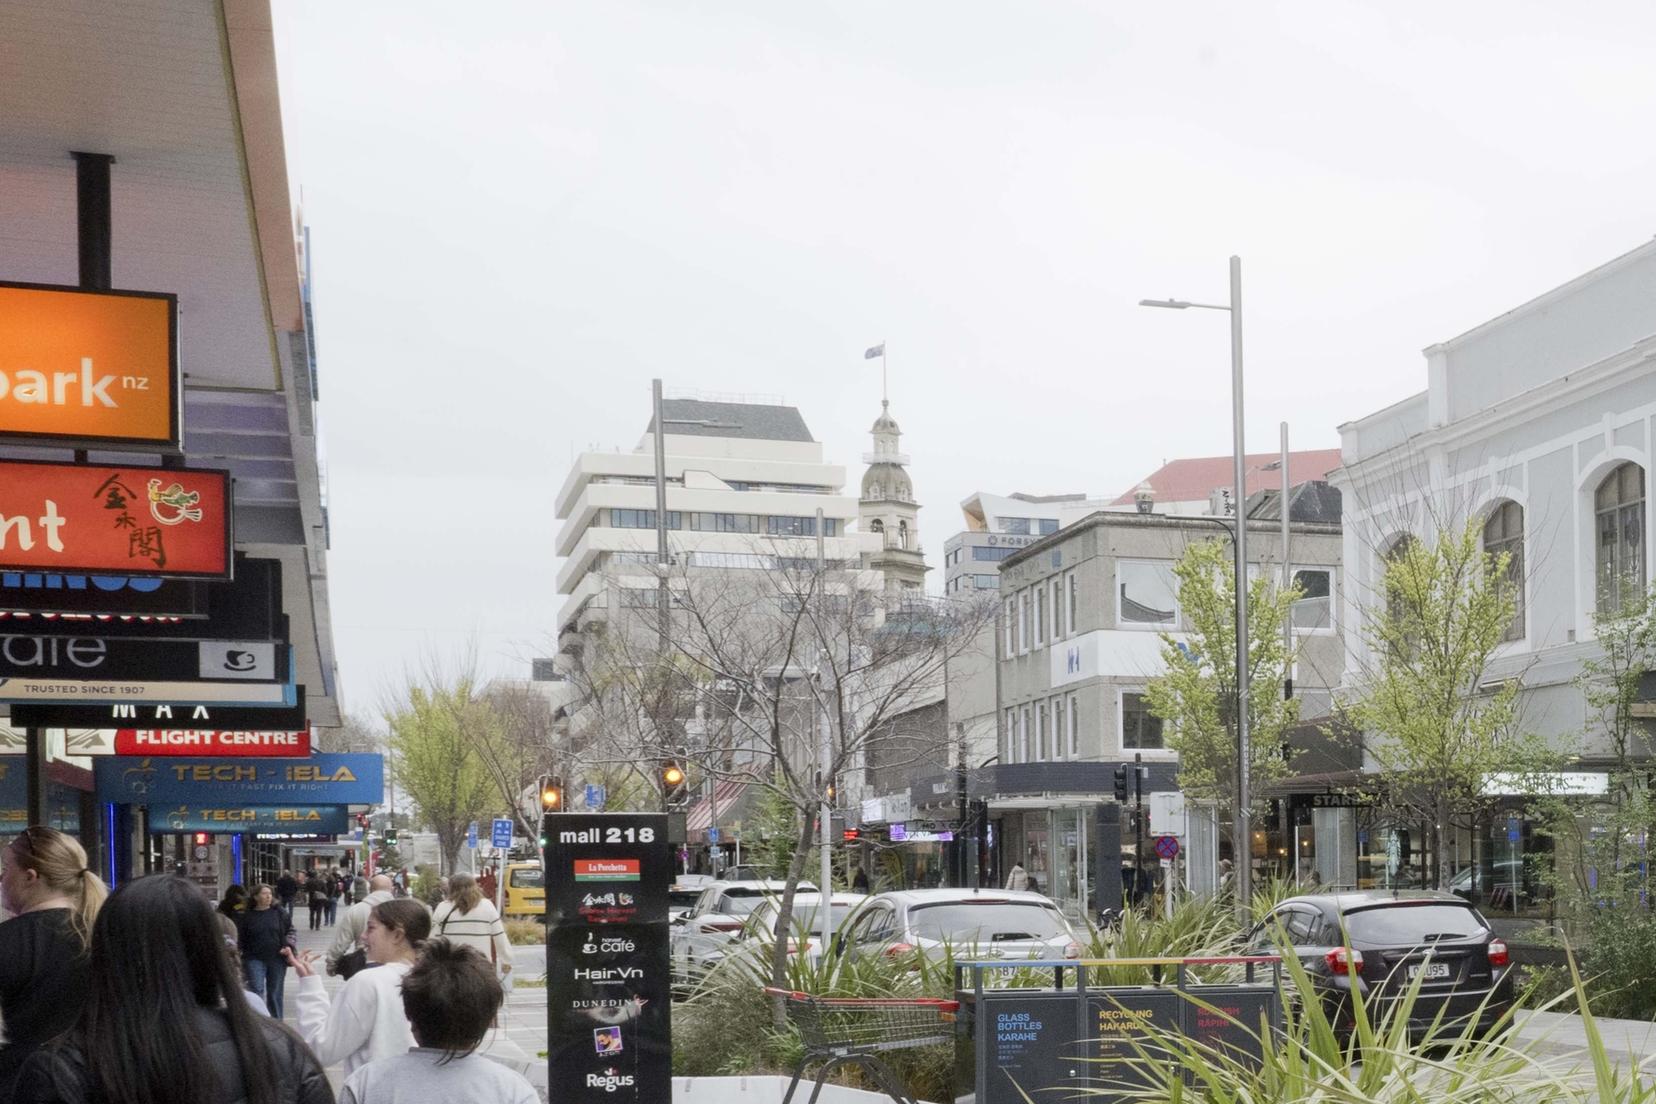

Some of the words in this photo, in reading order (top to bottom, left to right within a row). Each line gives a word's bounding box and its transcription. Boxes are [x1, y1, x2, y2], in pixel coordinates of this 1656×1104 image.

[122, 375, 149, 390] nz
[24, 685, 77, 694] TRUSTED
[81, 686, 115, 694] SINCE
[120, 686, 145, 695] 1907
[136, 730, 215, 745] FLIGHT
[219, 731, 299, 745] CENTRE
[170, 764, 257, 782] TECH
[201, 809, 257, 821] TECH
[560, 828, 600, 843] mall
[605, 827, 655, 843] 218
[600, 940, 635, 953] café
[574, 967, 644, 980] HairVn
[572, 999, 632, 1009] DUNEDIN
[998, 1013, 1030, 1022] GLASS
[998, 1021, 1042, 1031] BOTTLES
[998, 1032, 1037, 1041] KARAHE
[586, 1074, 634, 1092] Regus
